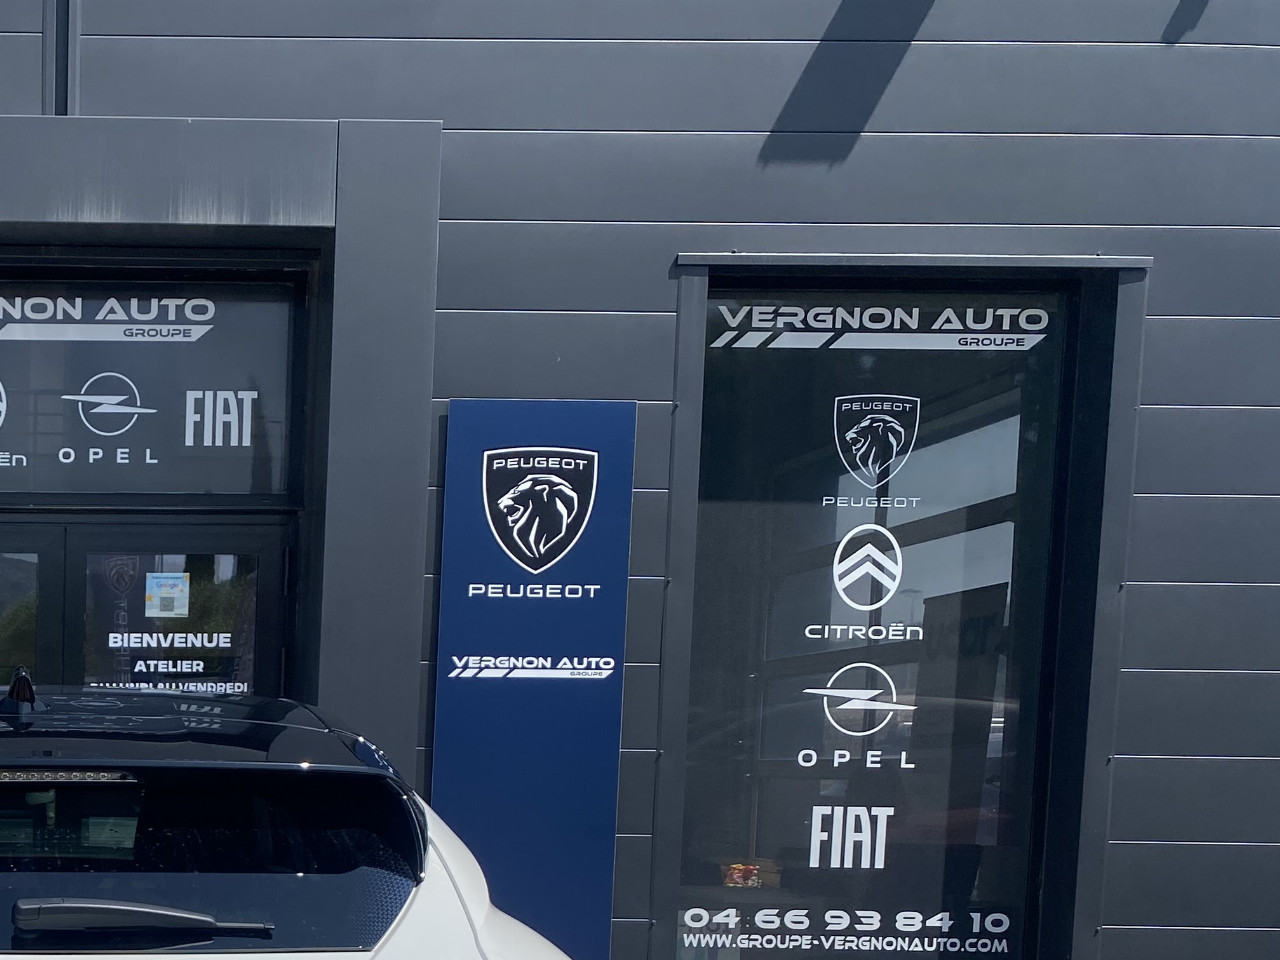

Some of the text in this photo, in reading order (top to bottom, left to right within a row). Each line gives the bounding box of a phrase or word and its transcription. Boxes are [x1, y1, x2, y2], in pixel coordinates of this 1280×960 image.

[94, 298, 216, 322] AUTO
[717, 305, 1050, 331] VERGNON AUTO
[123, 327, 193, 339] GROUPE
[957, 336, 1026, 347] GROUPE
[841, 401, 913, 412] PEUGEOT
[184, 390, 258, 447] FIAT
[58, 447, 158, 464] OPEL
[492, 457, 588, 470] PEUGEOT
[822, 496, 921, 508] PEUGEOT
[468, 583, 601, 598] PEUGEOT
[108, 632, 232, 648] BIENVENUE
[133, 660, 205, 673] ATELIER
[451, 656, 615, 669] VERGNON AUTO
[796, 749, 916, 769] OPEL
[809, 805, 894, 869] FIAT
[683, 907, 1010, 933] 04 66 93 84 10
[683, 933, 1008, 953] WWW.GROUPE-VERGNONAUTO.COM
